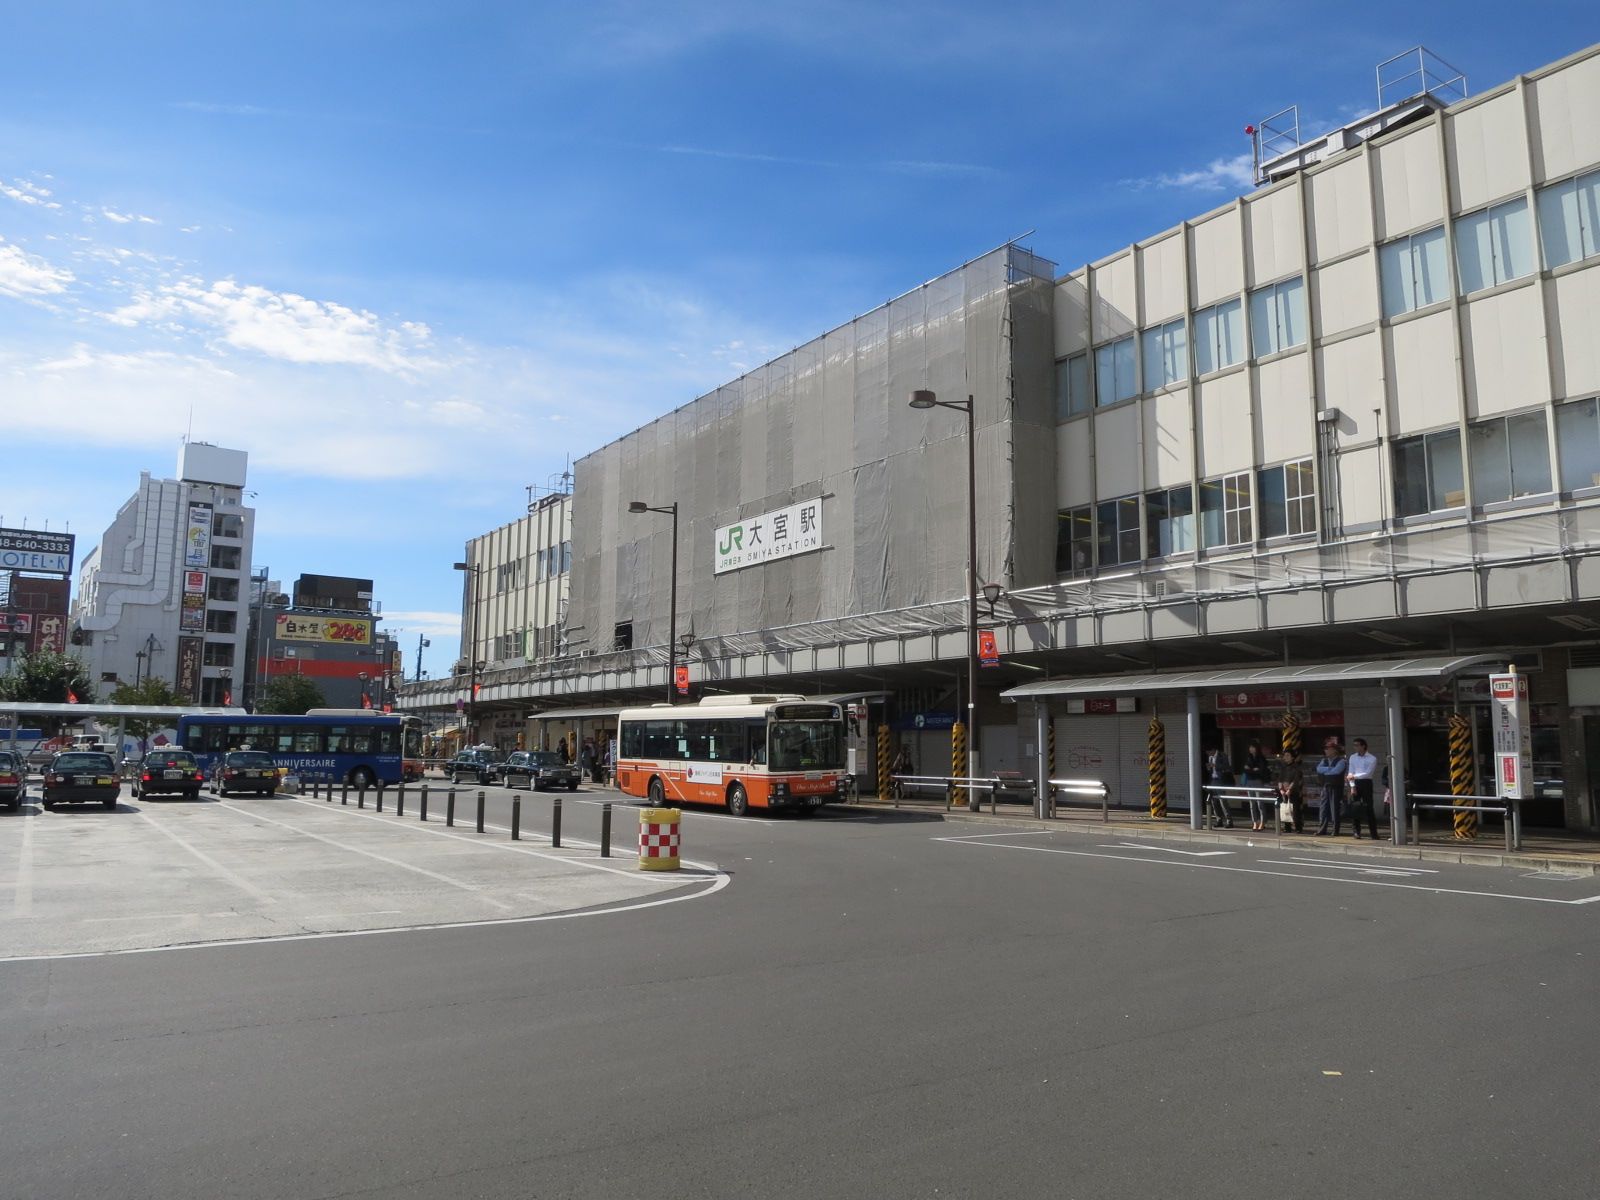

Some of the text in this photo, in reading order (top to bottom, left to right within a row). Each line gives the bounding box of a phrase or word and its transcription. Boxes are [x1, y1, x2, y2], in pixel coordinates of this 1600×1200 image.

[720, 505, 816, 556] JR 大宮駅
[774, 536, 817, 555] STATION
